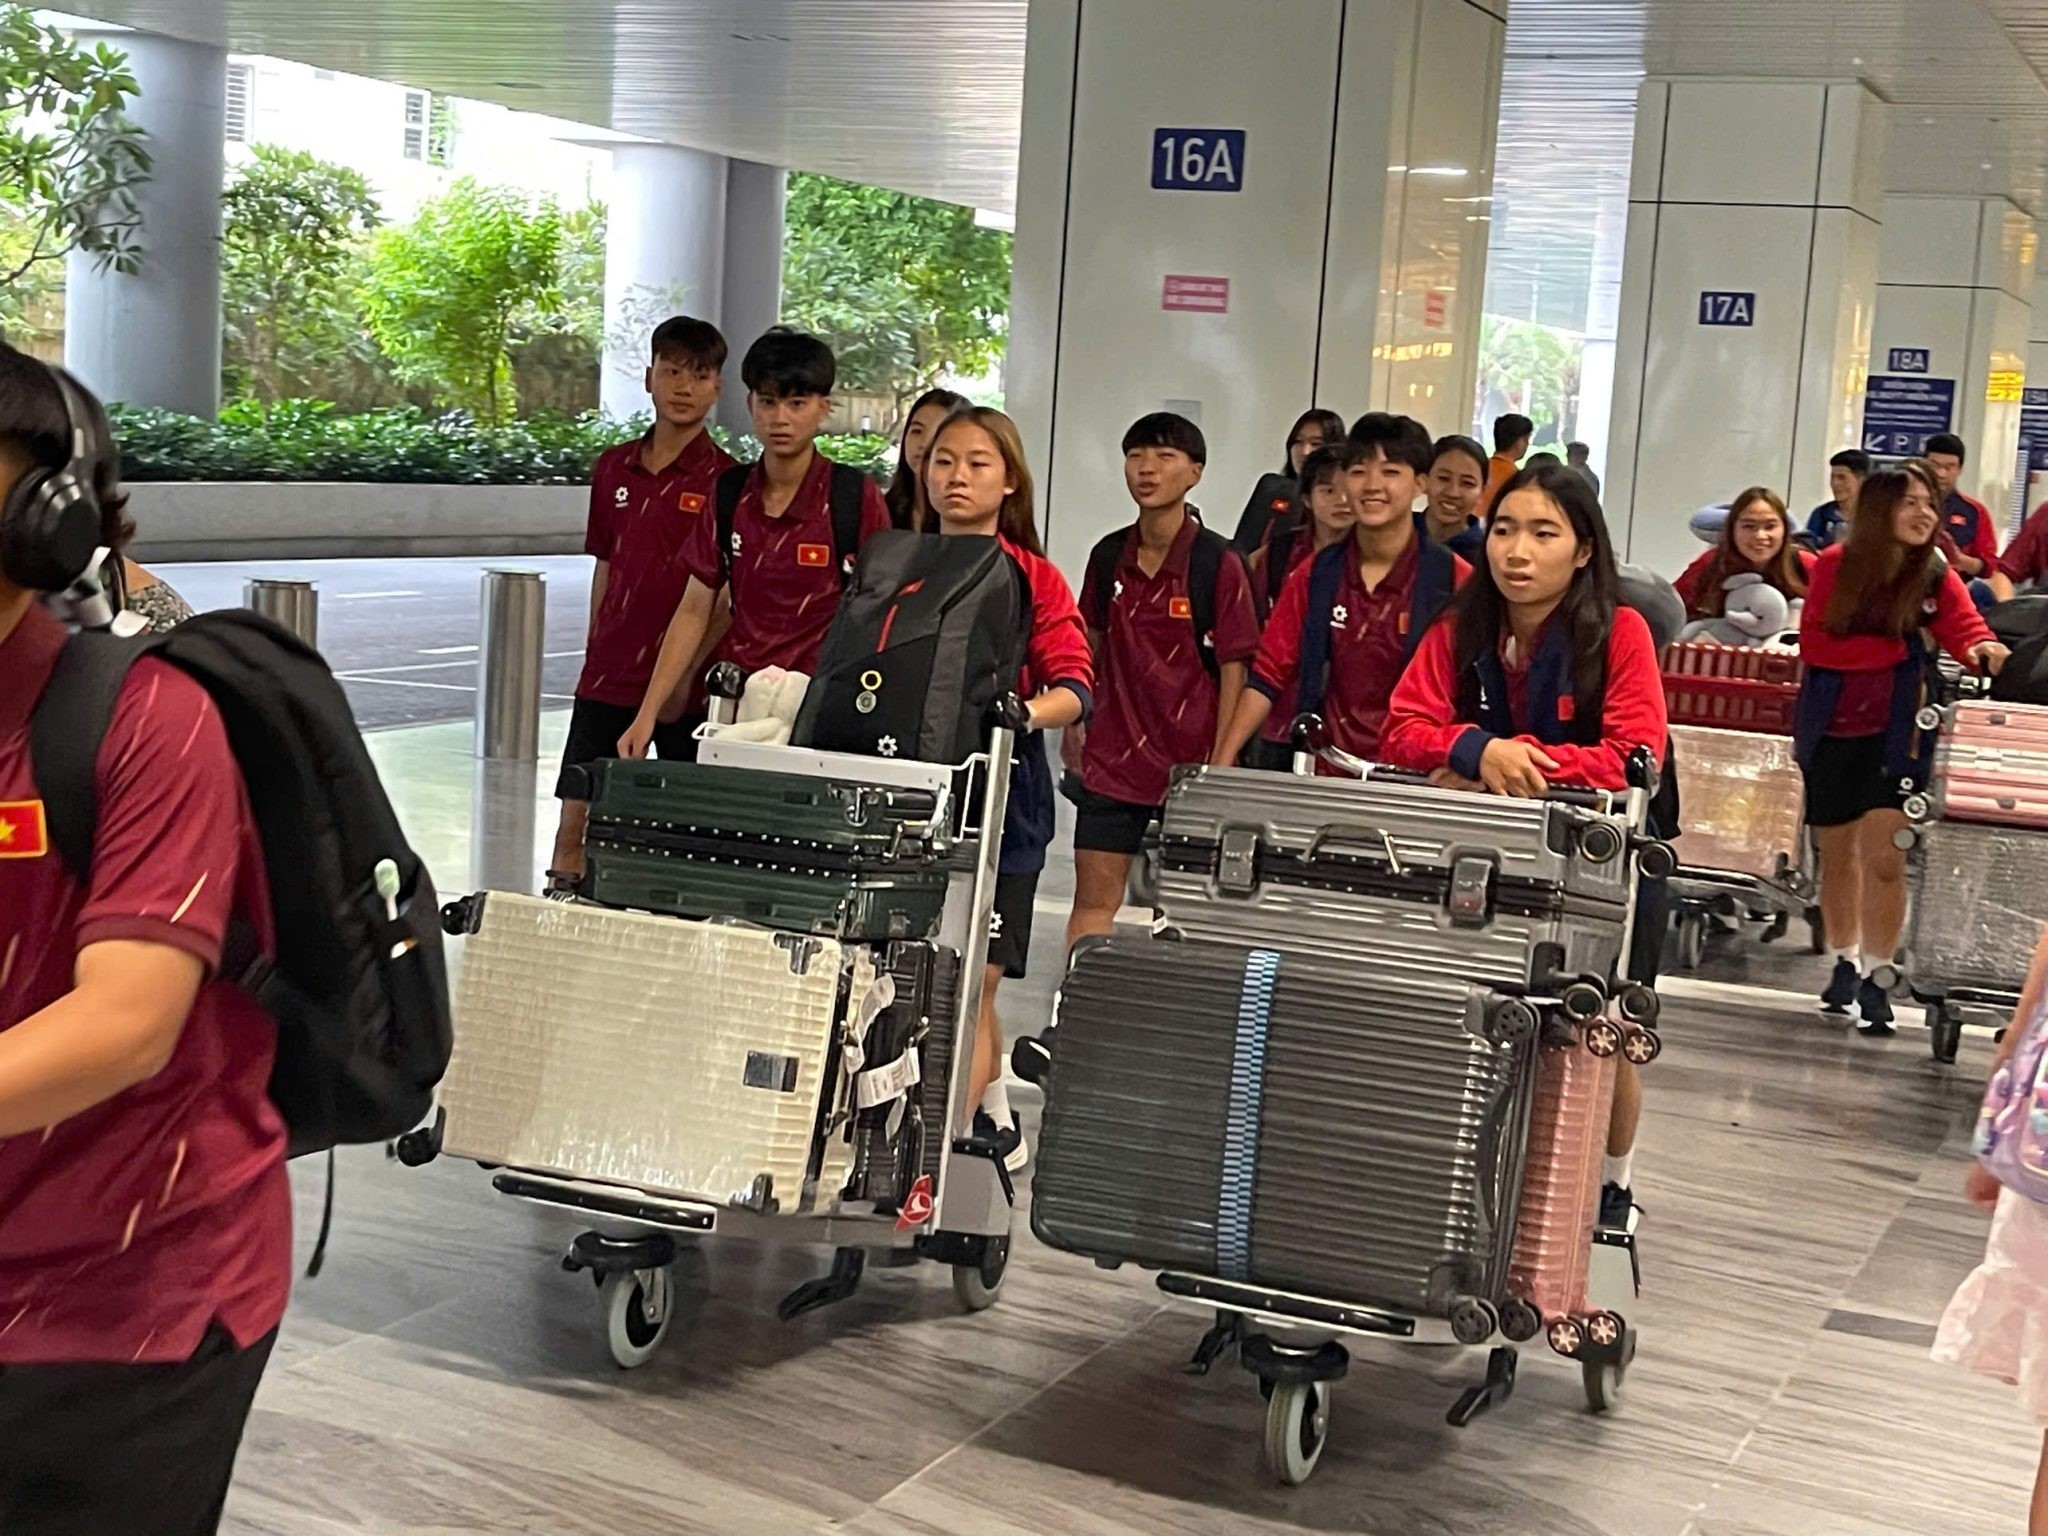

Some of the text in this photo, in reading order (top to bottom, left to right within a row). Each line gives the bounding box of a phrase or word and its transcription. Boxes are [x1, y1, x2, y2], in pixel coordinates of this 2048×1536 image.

[1161, 137, 1235, 183] 16A
[1704, 296, 1749, 322] 17A
[1892, 351, 1925, 370] 18A
[1895, 434, 1909, 451] P
